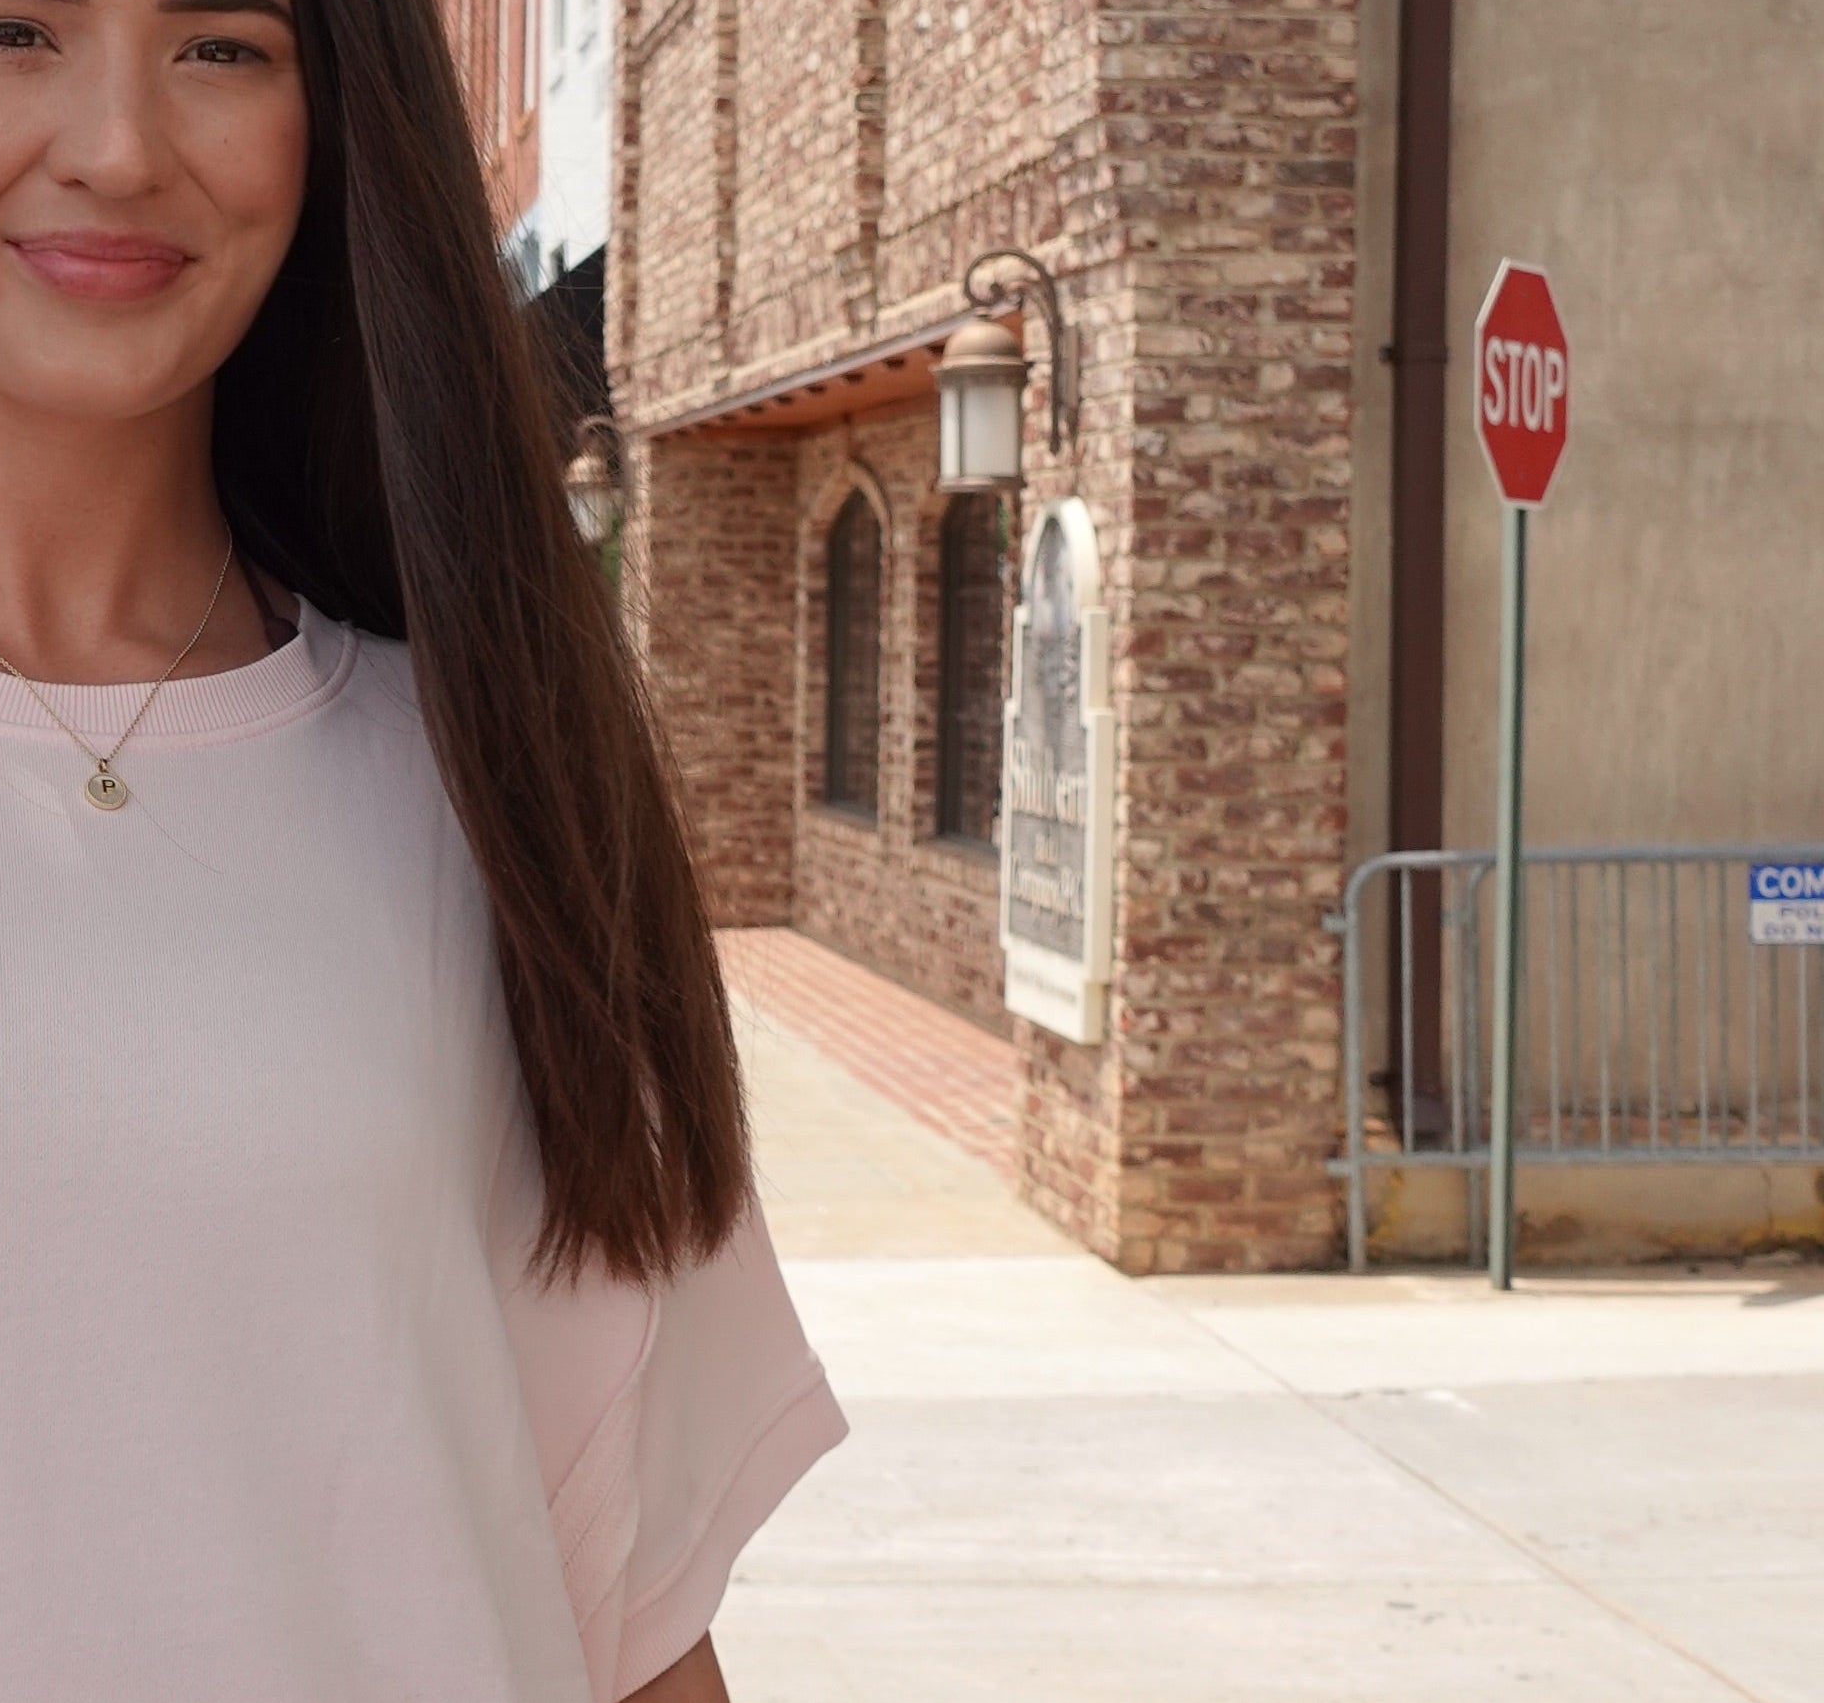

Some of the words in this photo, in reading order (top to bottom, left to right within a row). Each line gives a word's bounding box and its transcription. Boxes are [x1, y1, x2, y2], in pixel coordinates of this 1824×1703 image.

[1483, 335, 1565, 433] STOP
[102, 779, 116, 793] P
[1758, 866, 1824, 898] COM
